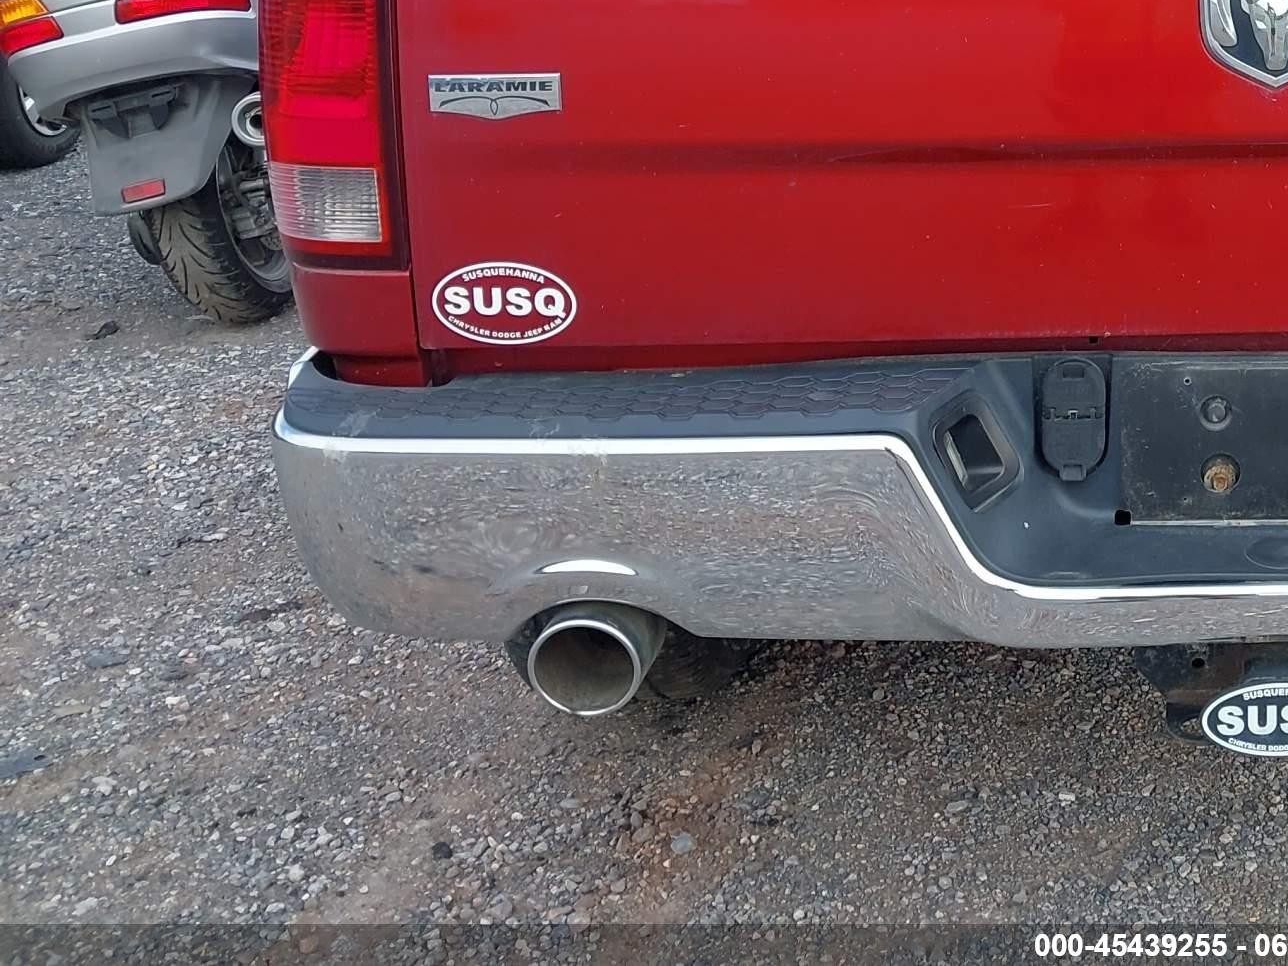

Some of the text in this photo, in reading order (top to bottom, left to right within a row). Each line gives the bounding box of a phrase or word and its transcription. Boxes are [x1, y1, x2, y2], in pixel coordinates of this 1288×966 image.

[434, 80, 553, 93] LARAMIE
[462, 267, 545, 284] SUSQUEHANNA
[443, 286, 567, 319] SUSQ
[447, 315, 491, 337] CHRYSLER
[492, 330, 522, 339] DODGE
[523, 328, 544, 338] JEEP
[1228, 737, 1268, 751] CHRYSLER
